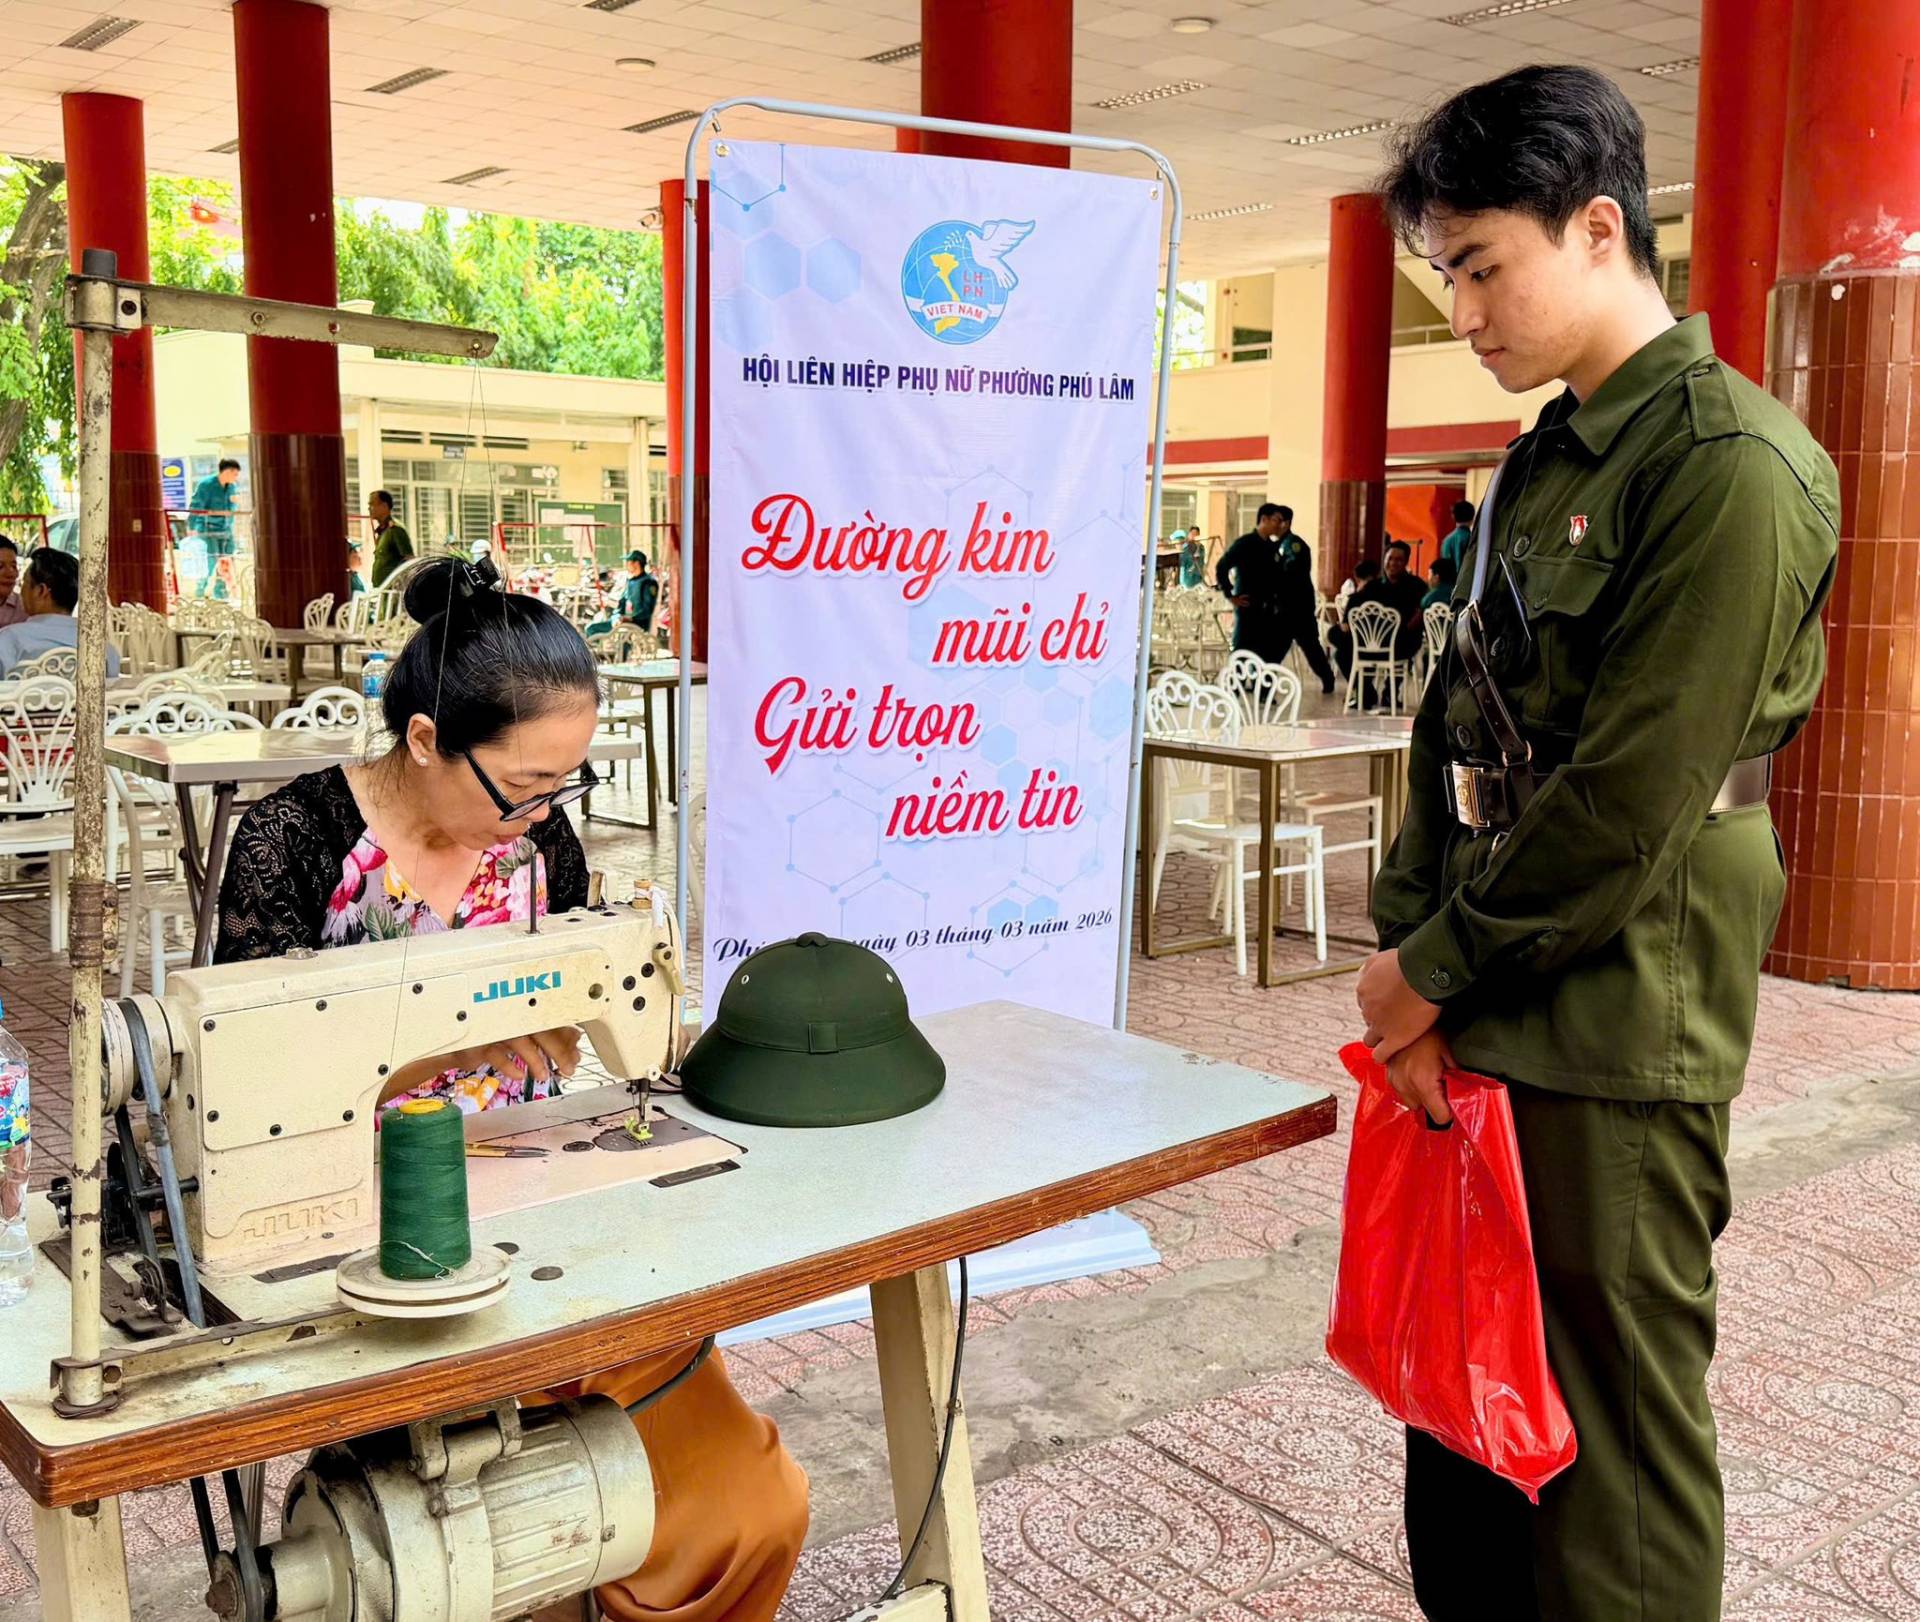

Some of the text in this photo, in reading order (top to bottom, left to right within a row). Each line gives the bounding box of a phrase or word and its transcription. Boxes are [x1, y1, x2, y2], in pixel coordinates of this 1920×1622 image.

[958, 305, 983, 319] NAM
[743, 353, 1135, 401] HỘI LIÊN HIỆP PHỤ NỮ PHƯỜNG PHÚ LÂM
[741, 493, 1055, 601] Đường kim
[931, 591, 1109, 664] mũi chỉ
[754, 676, 981, 775] Gửi trọn
[885, 768, 1083, 838] niềm tin
[713, 937, 766, 962] Ph
[905, 930, 930, 947] 03
[935, 925, 994, 945] tháng
[1000, 920, 1024, 938] 03
[1028, 918, 1069, 935] năm
[1075, 906, 1113, 930] 2026
[473, 971, 562, 1003] JUKI
